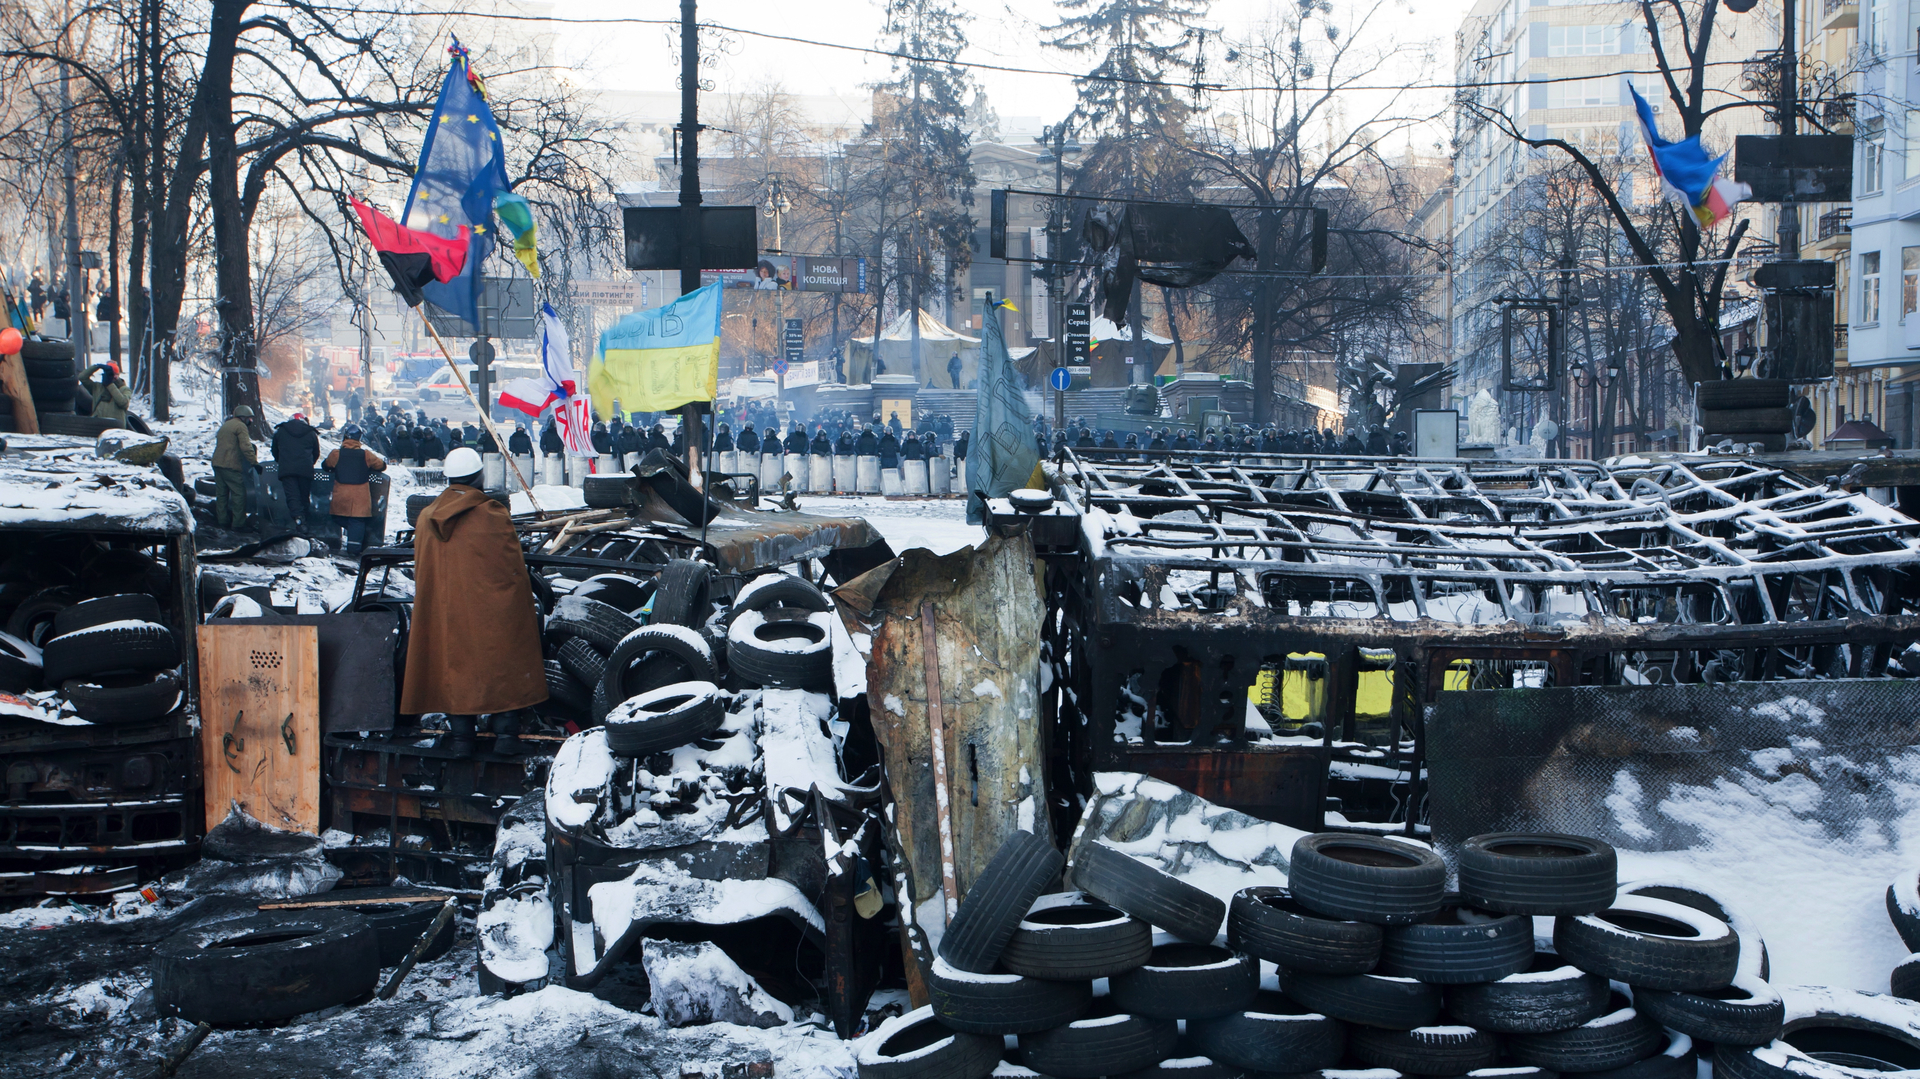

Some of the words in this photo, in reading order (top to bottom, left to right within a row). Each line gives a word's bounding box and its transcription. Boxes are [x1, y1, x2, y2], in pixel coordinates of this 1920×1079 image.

[812, 265, 838, 274] НОВА
[802, 275, 848, 286] КОЛЕКЦІЯ
[592, 291, 624, 299] ЛІФТИНГ
[1068, 318, 1090, 327] Сервіс
